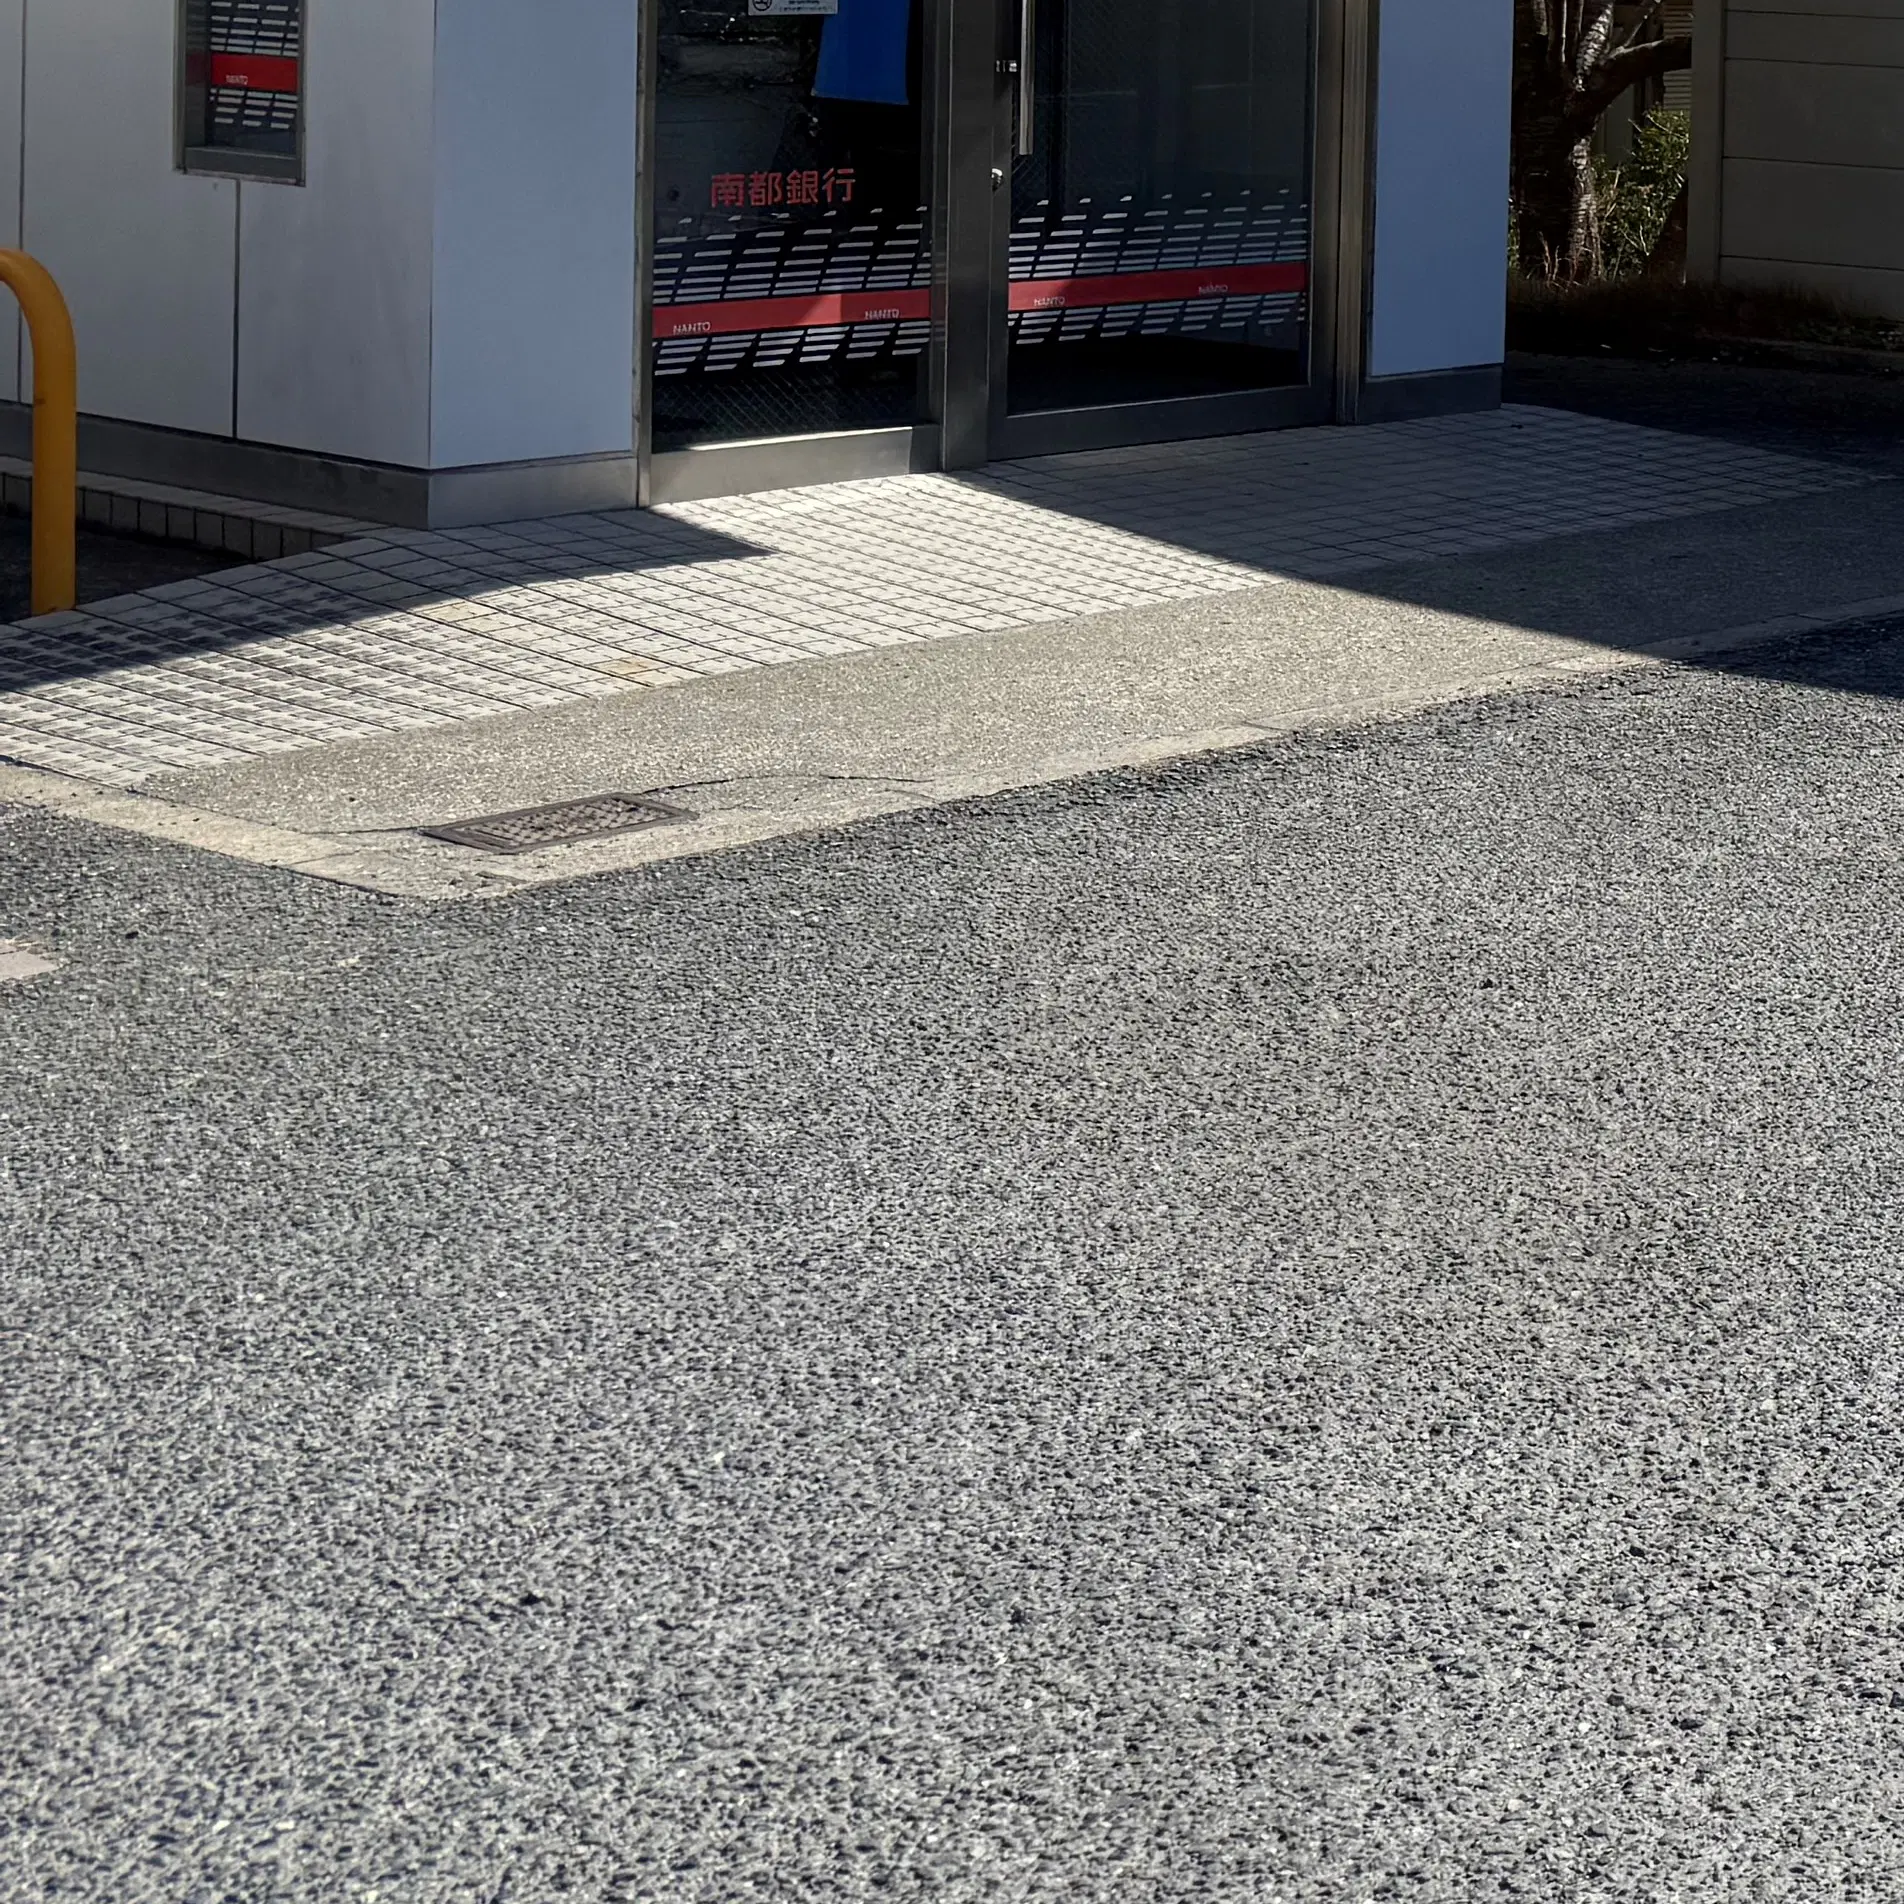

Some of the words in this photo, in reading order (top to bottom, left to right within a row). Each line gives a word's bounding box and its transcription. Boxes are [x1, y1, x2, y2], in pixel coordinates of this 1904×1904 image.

[710, 167, 857, 208] 南都銀行
[672, 321, 712, 334] NANTO
